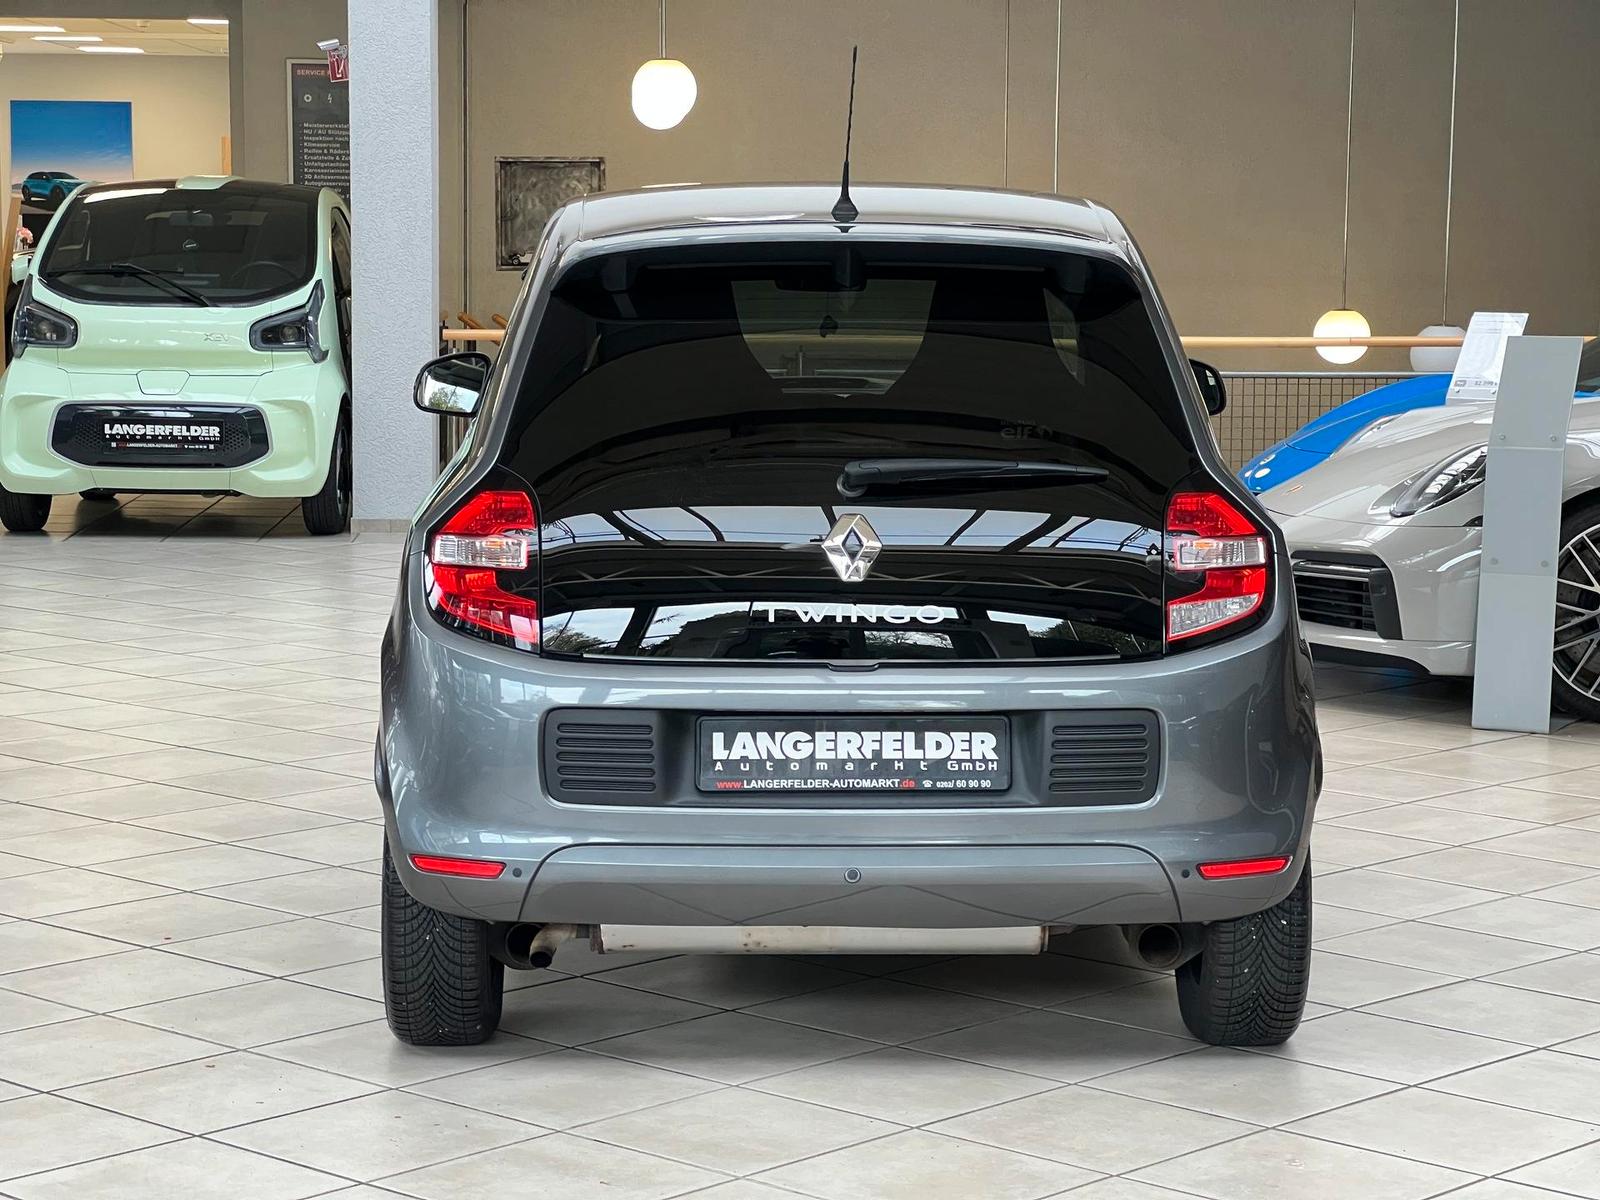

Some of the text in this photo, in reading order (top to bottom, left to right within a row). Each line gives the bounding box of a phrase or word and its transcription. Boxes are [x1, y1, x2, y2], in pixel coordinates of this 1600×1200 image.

[296, 68, 325, 76] SERVICE
[104, 423, 221, 437] LANGERFELDER
[762, 604, 946, 624] TWINGO
[712, 731, 999, 760] LANGERFELDER
[946, 760, 999, 771] GmbH
[716, 778, 916, 790] www.LANGERFELDER-AUTOMARKT.de
